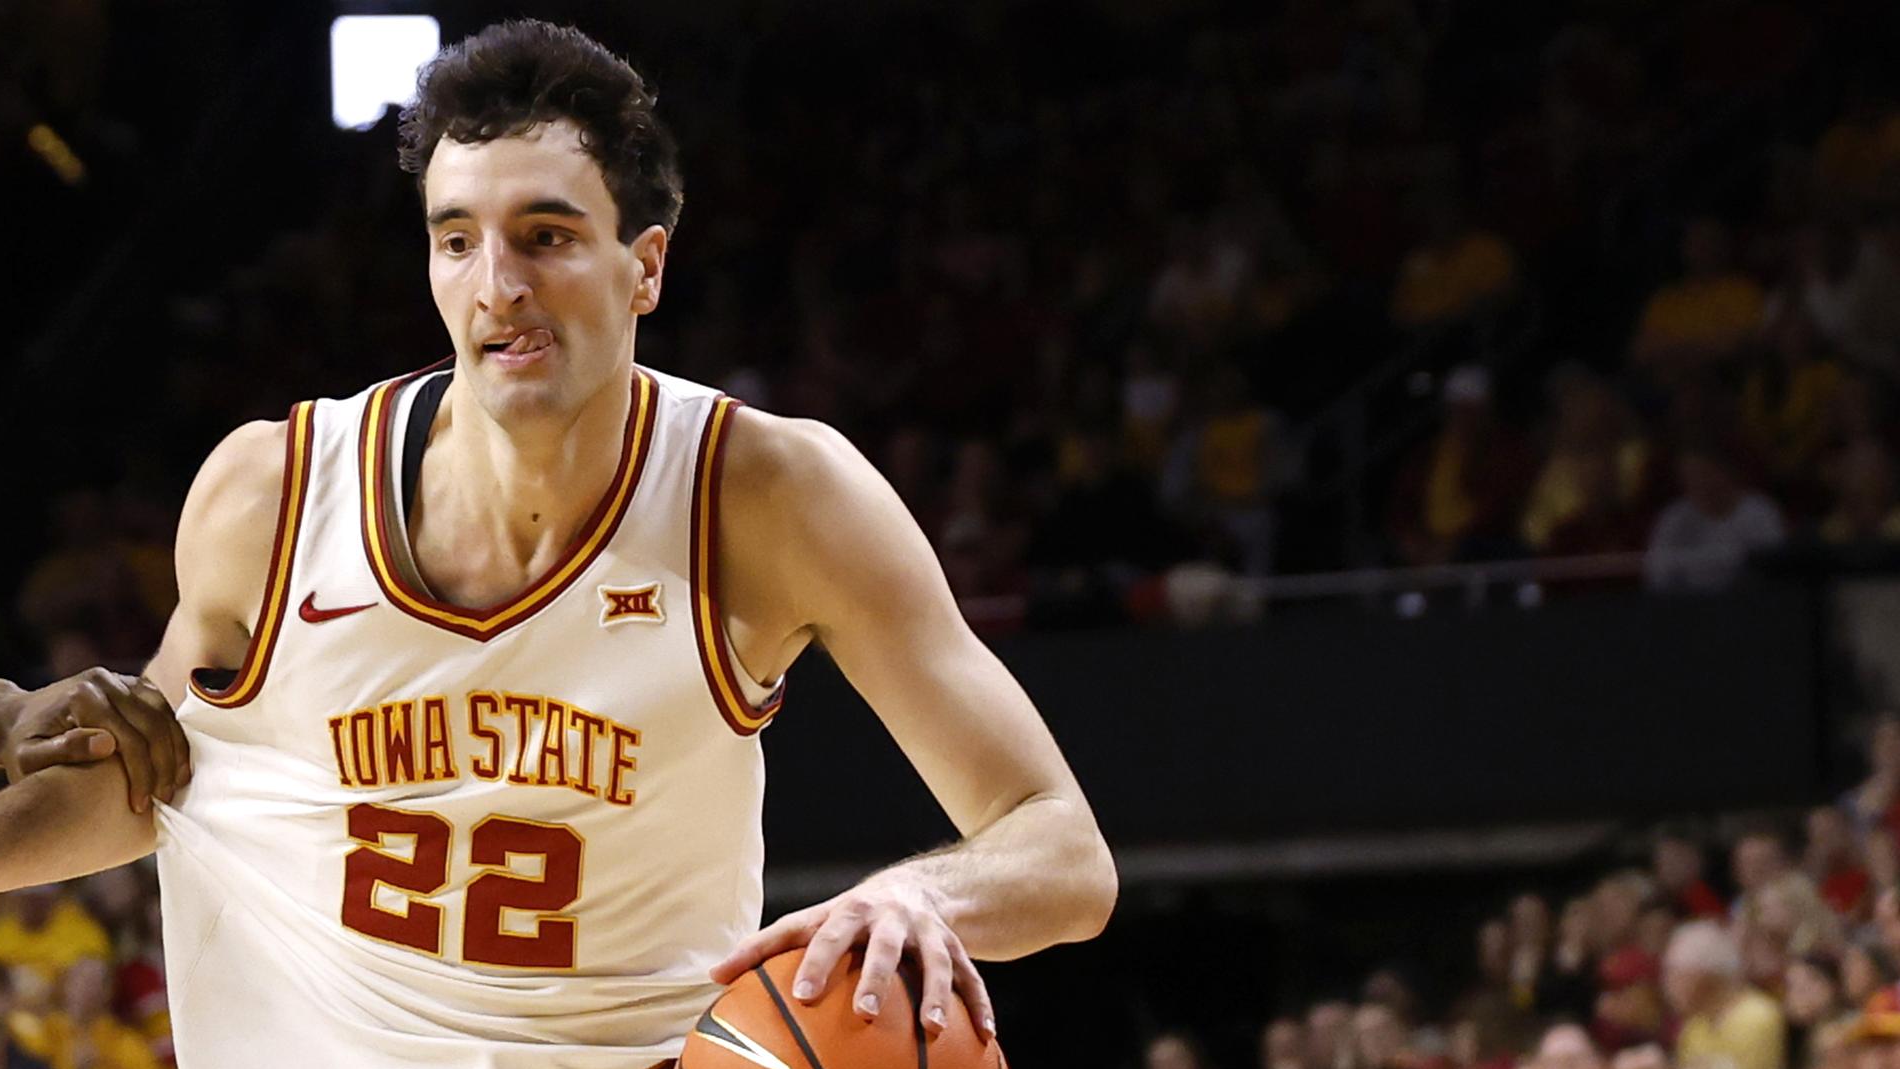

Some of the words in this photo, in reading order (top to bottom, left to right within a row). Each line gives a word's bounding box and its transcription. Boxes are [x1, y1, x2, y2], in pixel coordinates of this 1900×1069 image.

[328, 695, 457, 787] IOWA
[467, 690, 642, 807] STATE
[340, 803, 586, 971] 22
